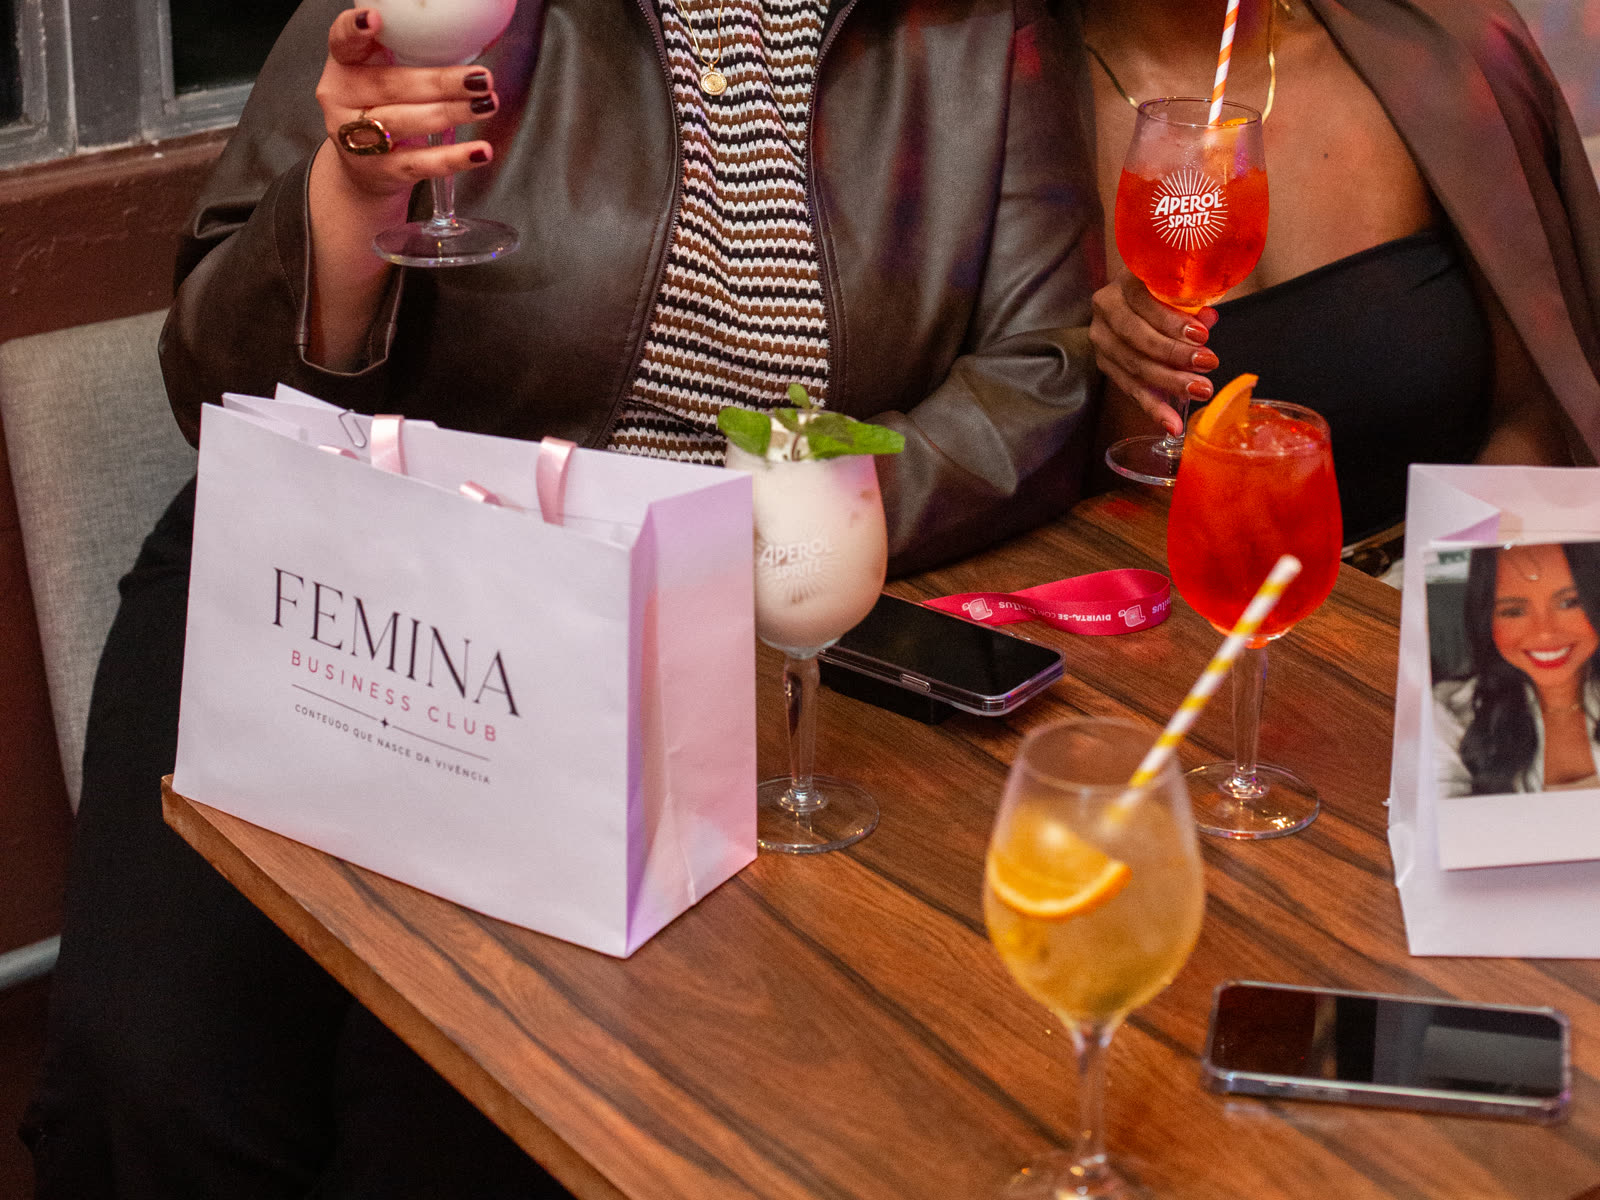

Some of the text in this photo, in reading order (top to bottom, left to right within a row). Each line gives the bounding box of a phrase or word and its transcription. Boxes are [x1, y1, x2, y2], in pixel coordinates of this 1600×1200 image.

[1154, 191, 1222, 215] APEROL
[1168, 211, 1210, 228] SPRITZ
[759, 537, 832, 566] APEROL
[272, 567, 521, 718] FEMINA
[291, 650, 497, 742] BUSINESS CLUB
[353, 728, 373, 743] QUE
[376, 738, 411, 758] NASCE
[415, 752, 431, 764] DA
[435, 759, 491, 785] VIVÊNCIA
